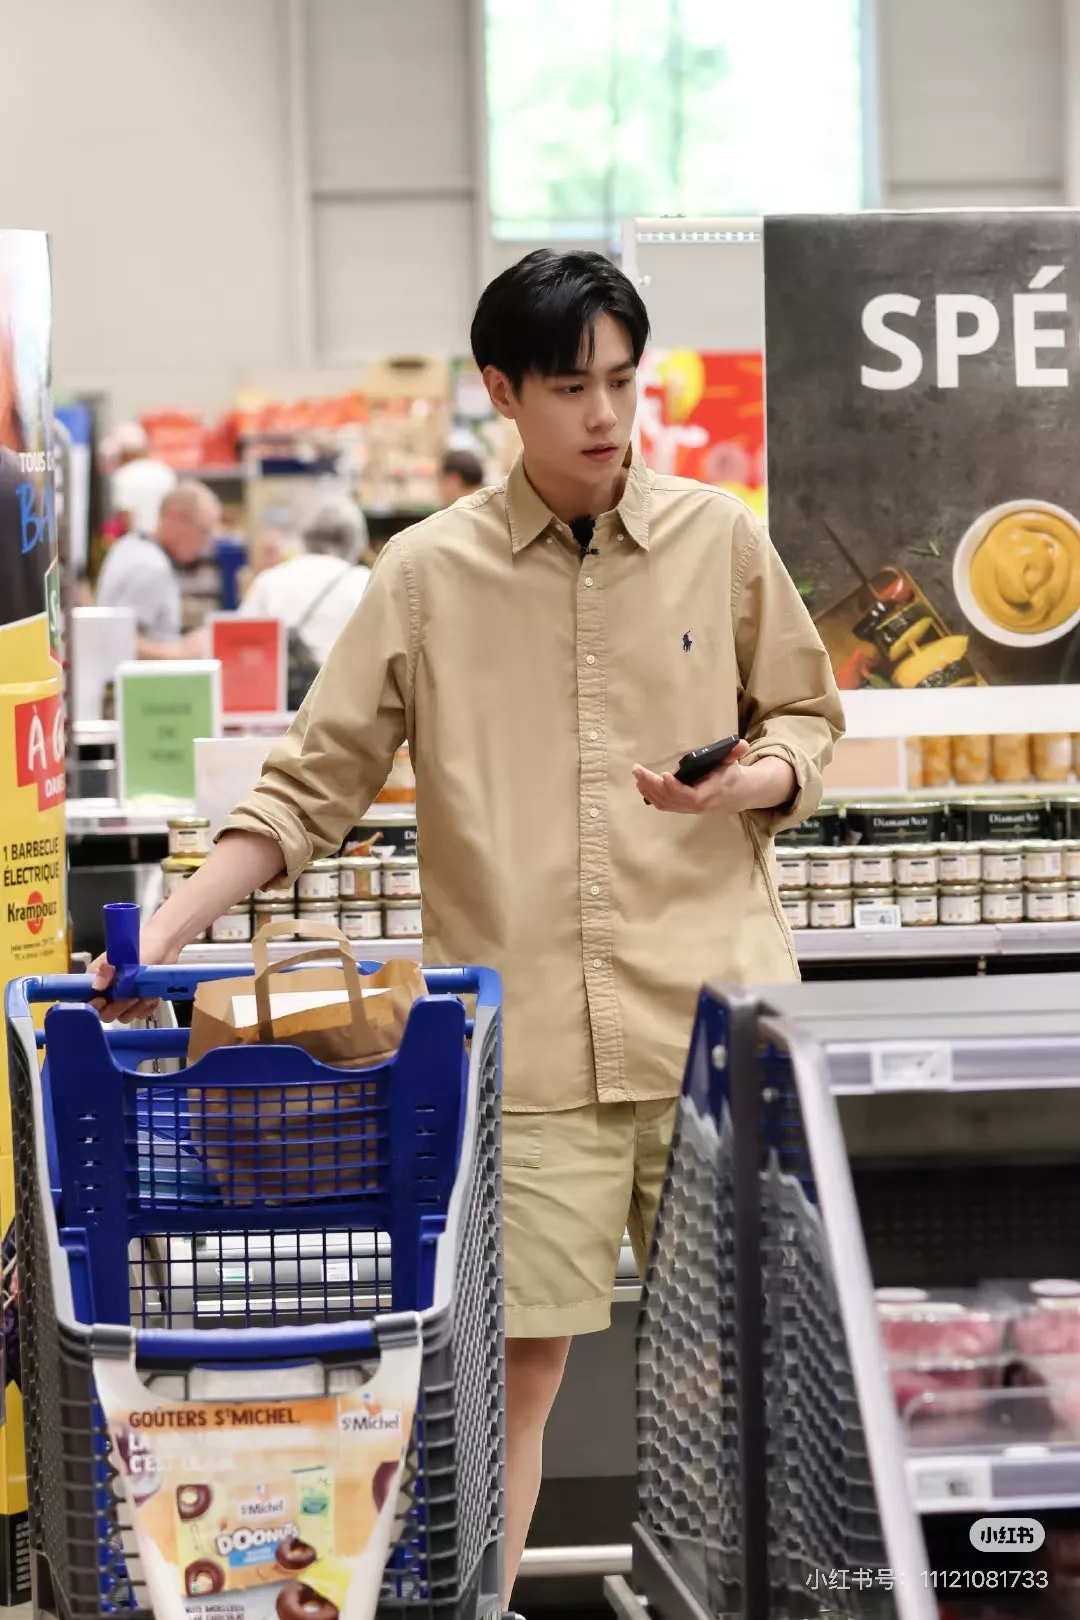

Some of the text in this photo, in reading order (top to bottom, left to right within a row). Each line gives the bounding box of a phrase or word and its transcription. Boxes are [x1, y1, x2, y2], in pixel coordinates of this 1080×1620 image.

[861, 265, 1080, 391] SPÉ
[19, 451, 46, 473] TOUS
[3, 836, 59, 862] 1 BARBECUE
[3, 861, 60, 888] ÉLECTRIQUE
[7, 900, 57, 925] Krampouz
[128, 1406, 208, 1429] GOÛTERS
